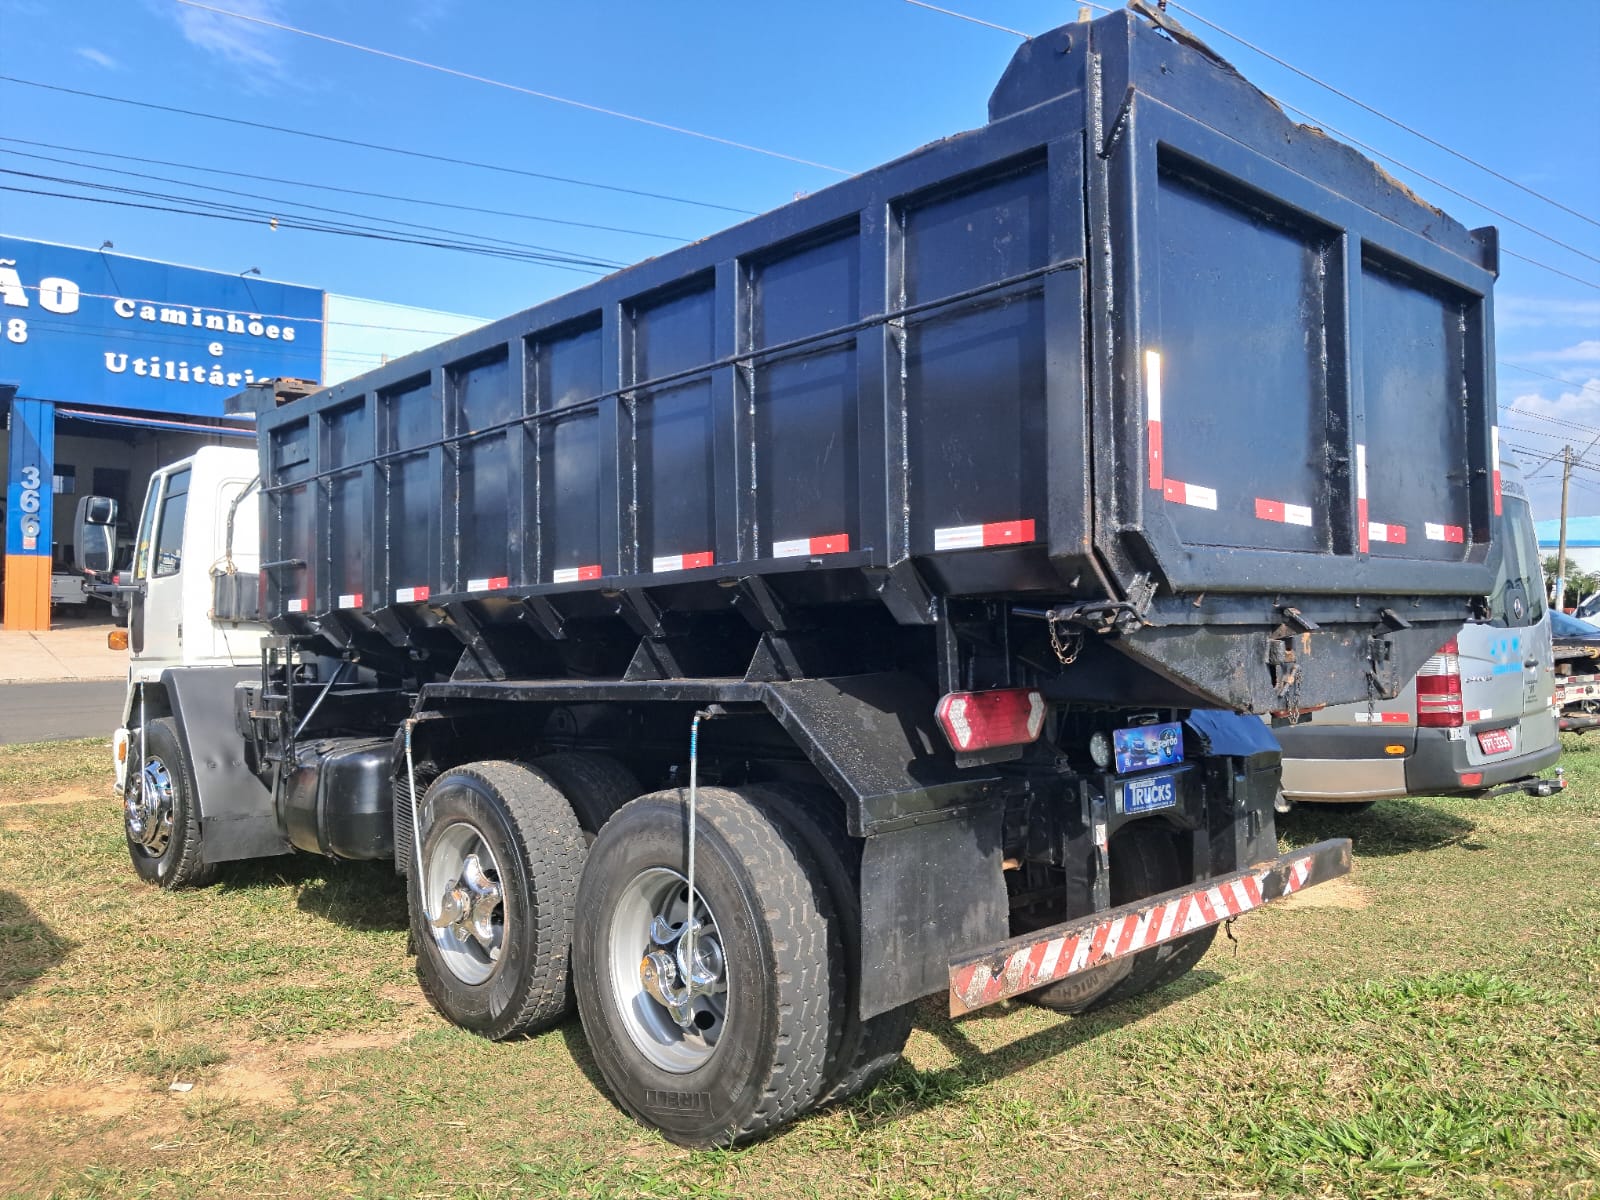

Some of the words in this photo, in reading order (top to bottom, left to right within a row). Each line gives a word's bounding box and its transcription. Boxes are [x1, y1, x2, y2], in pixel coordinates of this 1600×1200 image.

[0, 319, 28, 343] 8
[114, 299, 296, 341] Caminhões
[208, 342, 224, 356] e
[105, 352, 270, 387] Utilitári
[20, 466, 41, 538] 366
[1129, 784, 1172, 806] TRUCKS
